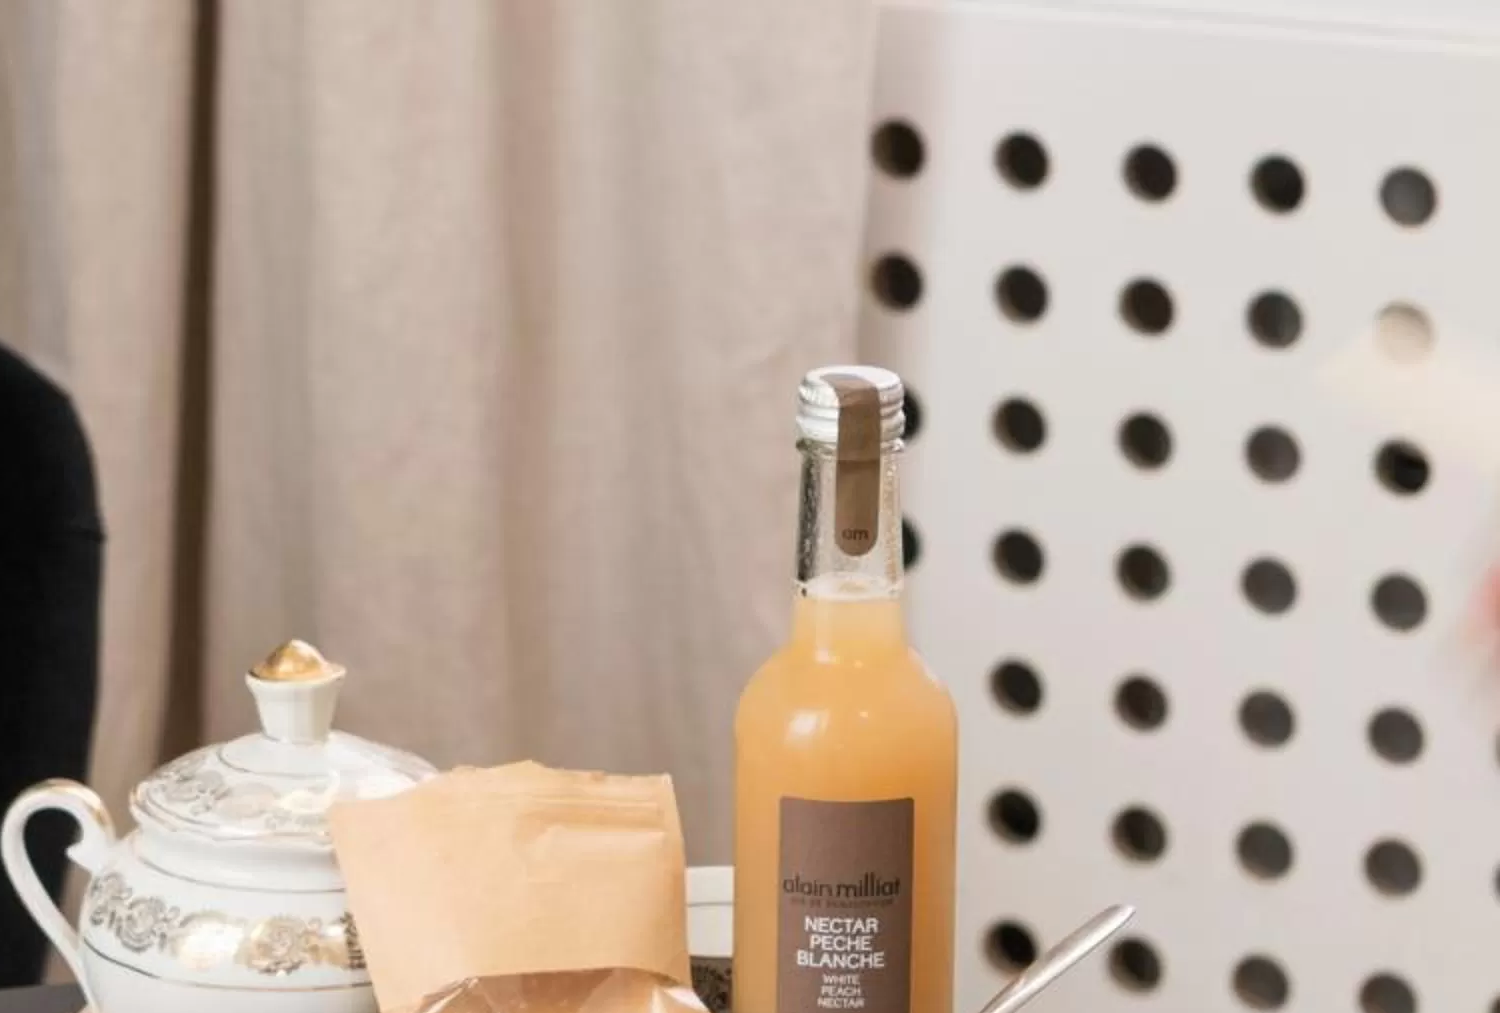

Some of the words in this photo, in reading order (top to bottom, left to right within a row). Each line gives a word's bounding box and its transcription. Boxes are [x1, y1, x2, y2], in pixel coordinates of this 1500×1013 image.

[783, 873, 832, 897] alain
[836, 872, 900, 897] milliat
[804, 915, 878, 934] NECTAR
[810, 934, 873, 951] PECHE
[797, 949, 885, 968] BLANCHE
[823, 974, 860, 985] WHITE
[821, 985, 861, 996] PEACH
[817, 997, 865, 1008] NECTAR
